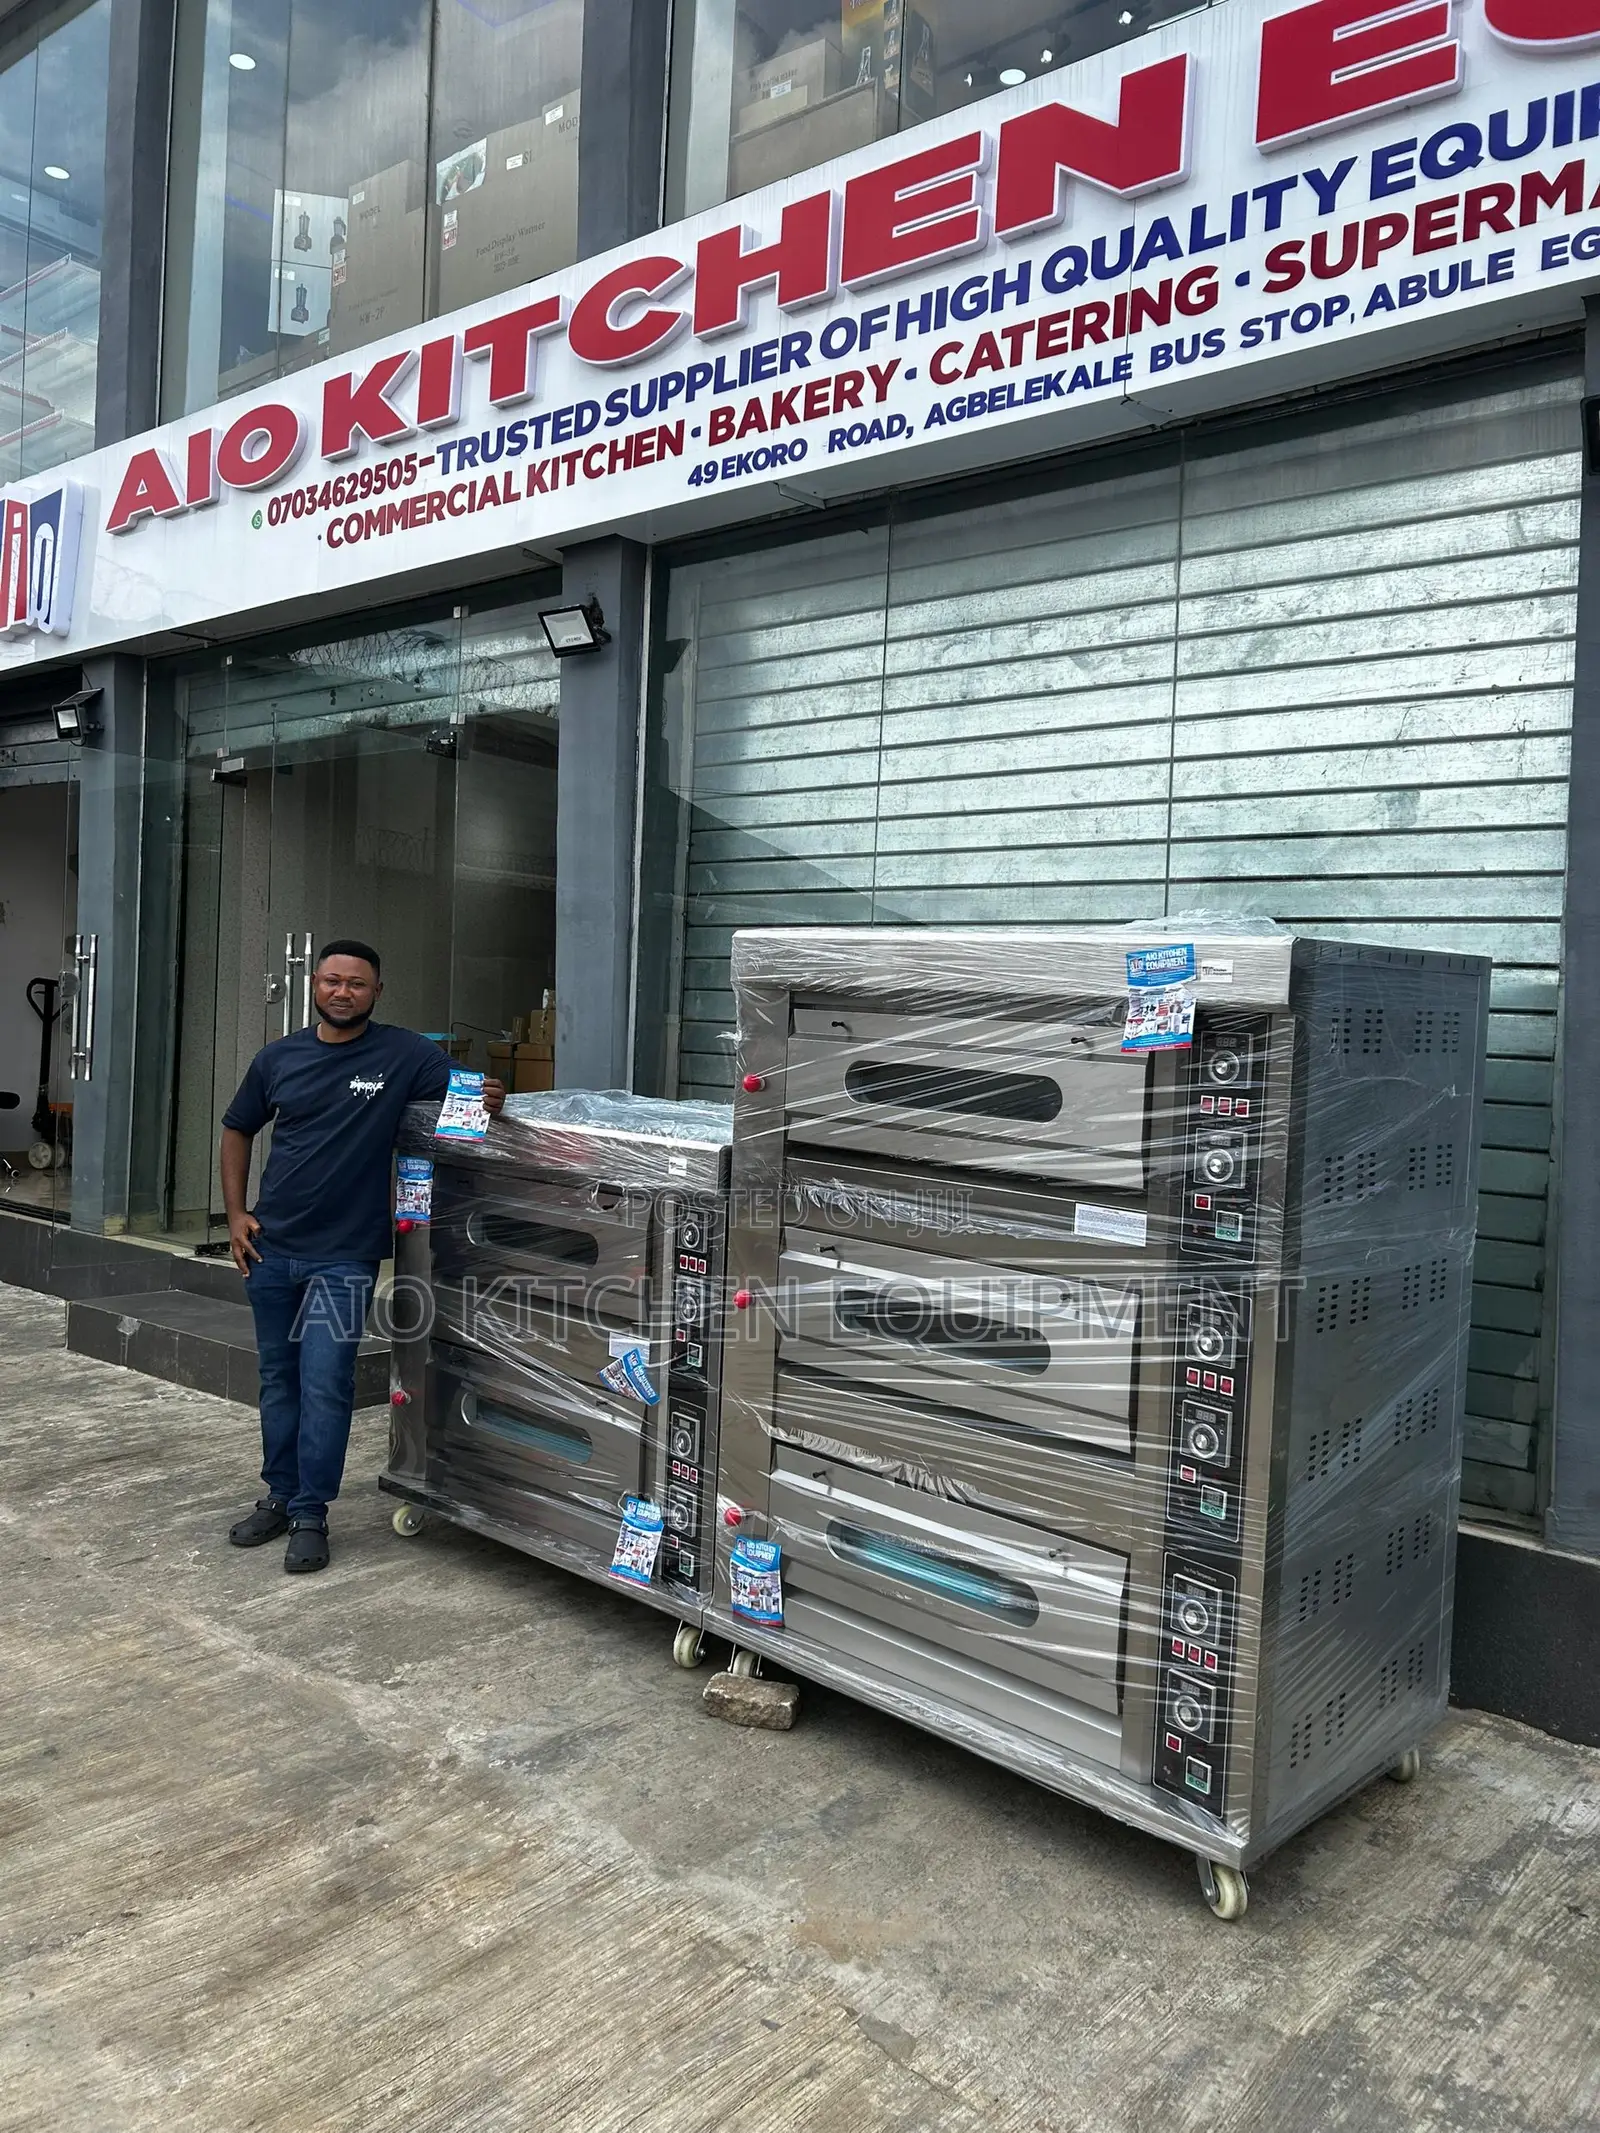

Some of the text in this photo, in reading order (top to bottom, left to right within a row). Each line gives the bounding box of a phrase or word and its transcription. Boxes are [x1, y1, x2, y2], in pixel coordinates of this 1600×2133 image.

[107, 403, 299, 531] AIO
[322, 55, 1186, 454] KITCHEN
[326, 159, 1600, 549] COMMERCIAL KITCHEN BAKERY CATERING SUPERM
[605, 332, 811, 426] SUPPLIER
[819, 308, 889, 360] OF
[895, 263, 1031, 342] HIGH
[1041, 159, 1357, 296] QUALITY
[688, 453, 718, 487] 49
[721, 438, 808, 482] EKORO
[924, 353, 1133, 430] AGBELEKALE
[1149, 328, 1226, 374] BUS
[1362, 248, 1515, 317] ABULE
[1145, 956, 1188, 971] EQUIPMENT
[746, 1548, 775, 1561] EQUIPMENT
